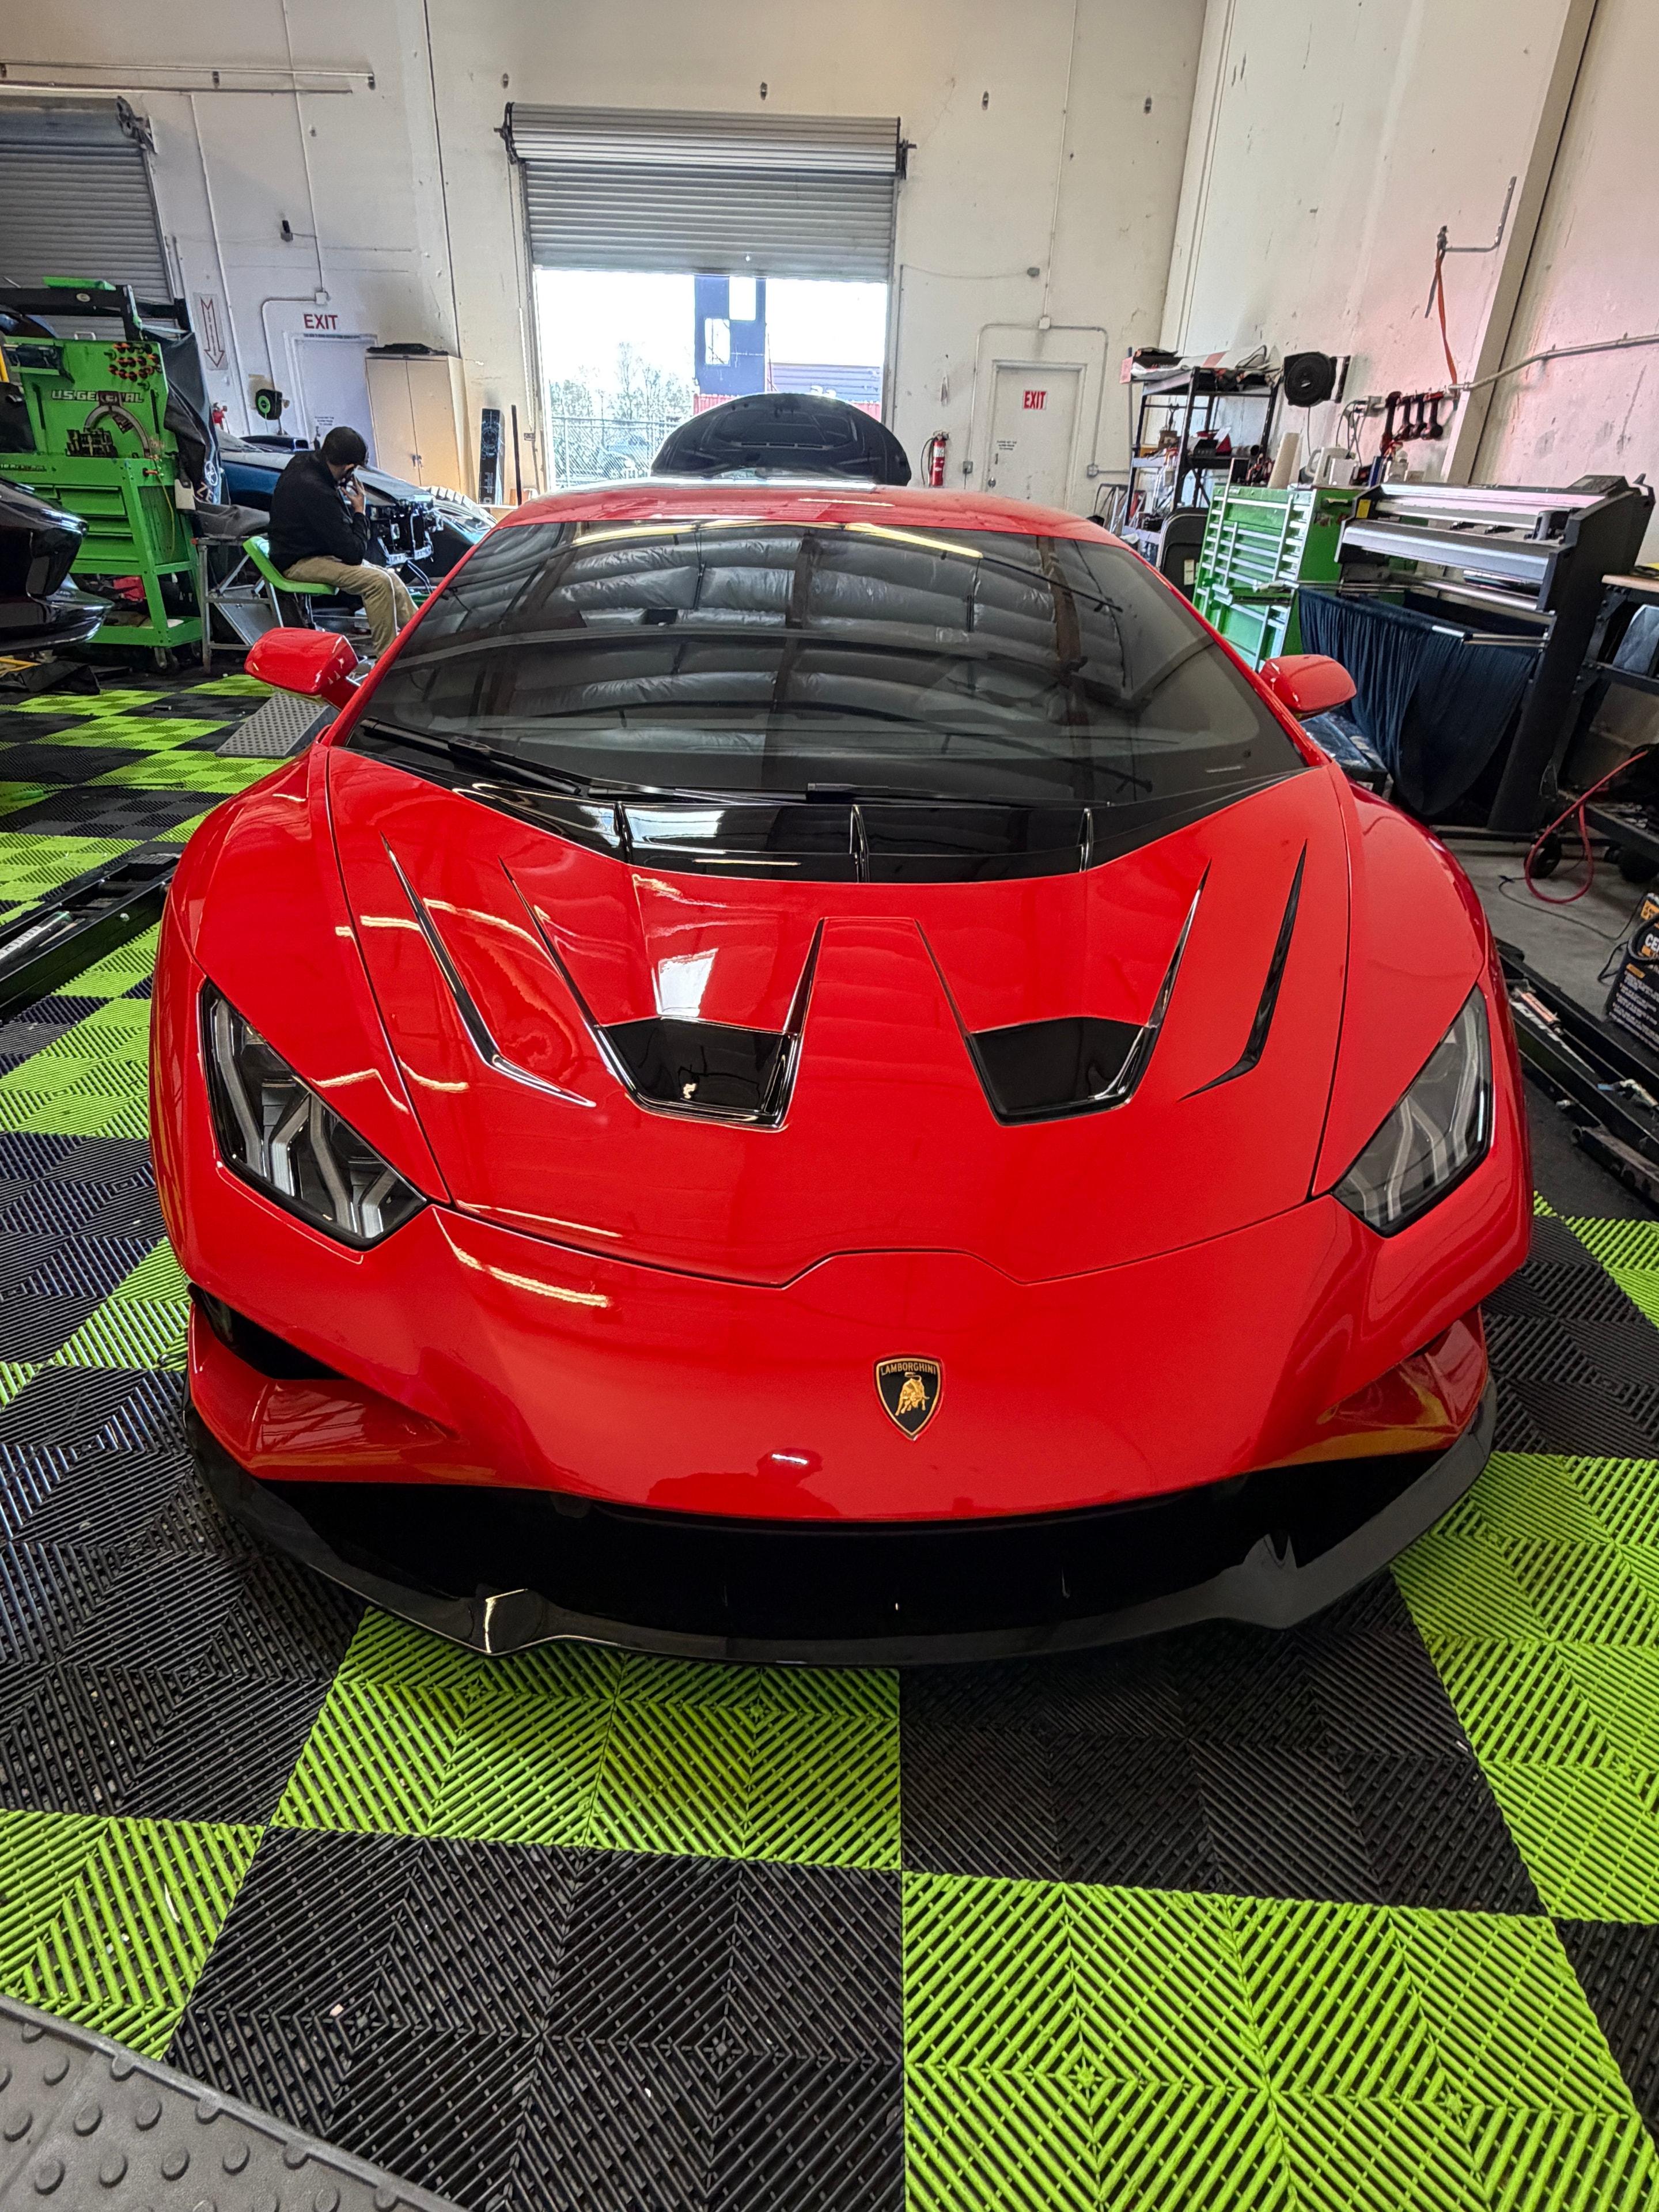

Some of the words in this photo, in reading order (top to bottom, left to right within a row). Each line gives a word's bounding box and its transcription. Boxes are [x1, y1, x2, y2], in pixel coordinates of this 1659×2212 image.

[304, 314, 338, 329] EXIT
[1024, 391, 1046, 409] EXIT
[881, 1362, 936, 1376] LAMBORGHINI
